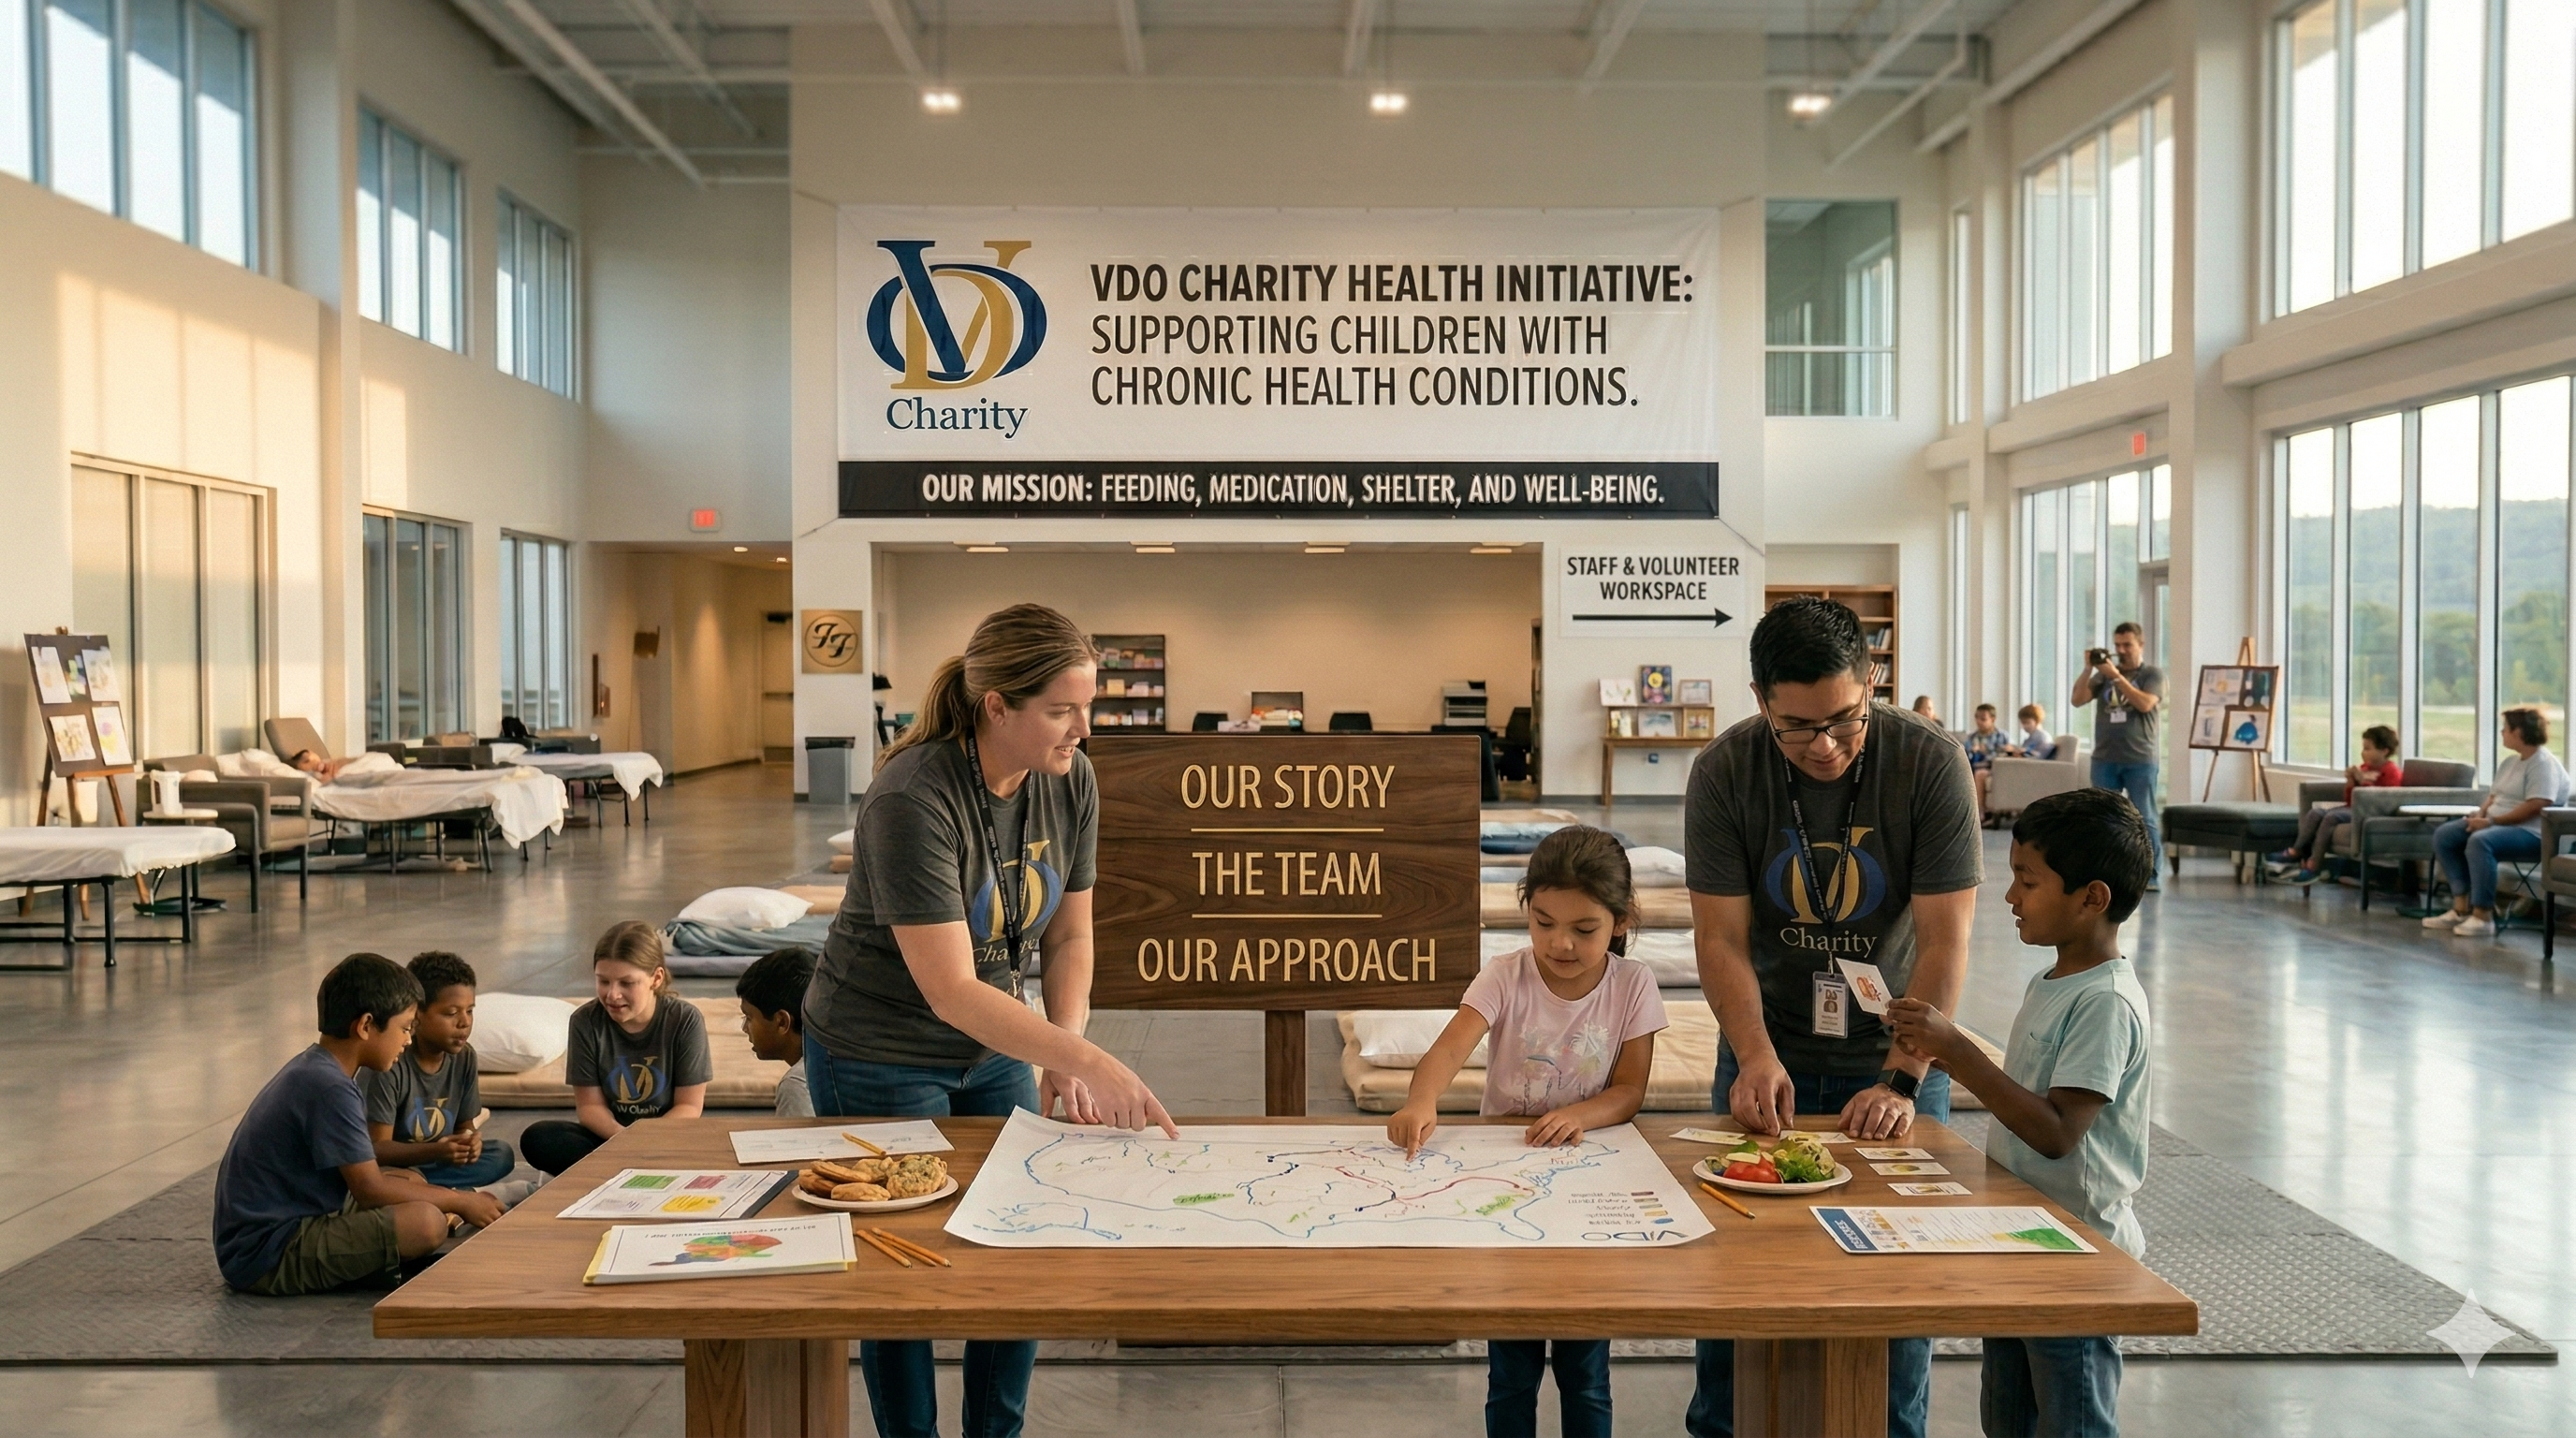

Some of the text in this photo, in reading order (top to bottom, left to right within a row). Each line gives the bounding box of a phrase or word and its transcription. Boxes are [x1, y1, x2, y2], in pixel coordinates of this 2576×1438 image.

[1090, 264, 1693, 302] VDO CHARITY HEALTH INITIATIVE:
[1091, 315, 1607, 355] SUPPORTING CHILDREN WITH
[1091, 366, 1639, 407] CHRONIC HEALTH CONDITIONS.
[886, 397, 1030, 439] Charity
[922, 474, 1665, 507] OUR MISSION: FEEDING, MEDICATION, SHELTER, AND WELL-BEING.
[1567, 556, 1739, 576] STAFF & VOLUNTEER
[1600, 581, 1707, 600] WORKSPACE
[1180, 765, 1396, 809] OUR STORY
[1192, 852, 1382, 896] THE TEAM
[1137, 938, 1437, 982] OUR APPROACH
[1779, 927, 1878, 958] Charity
